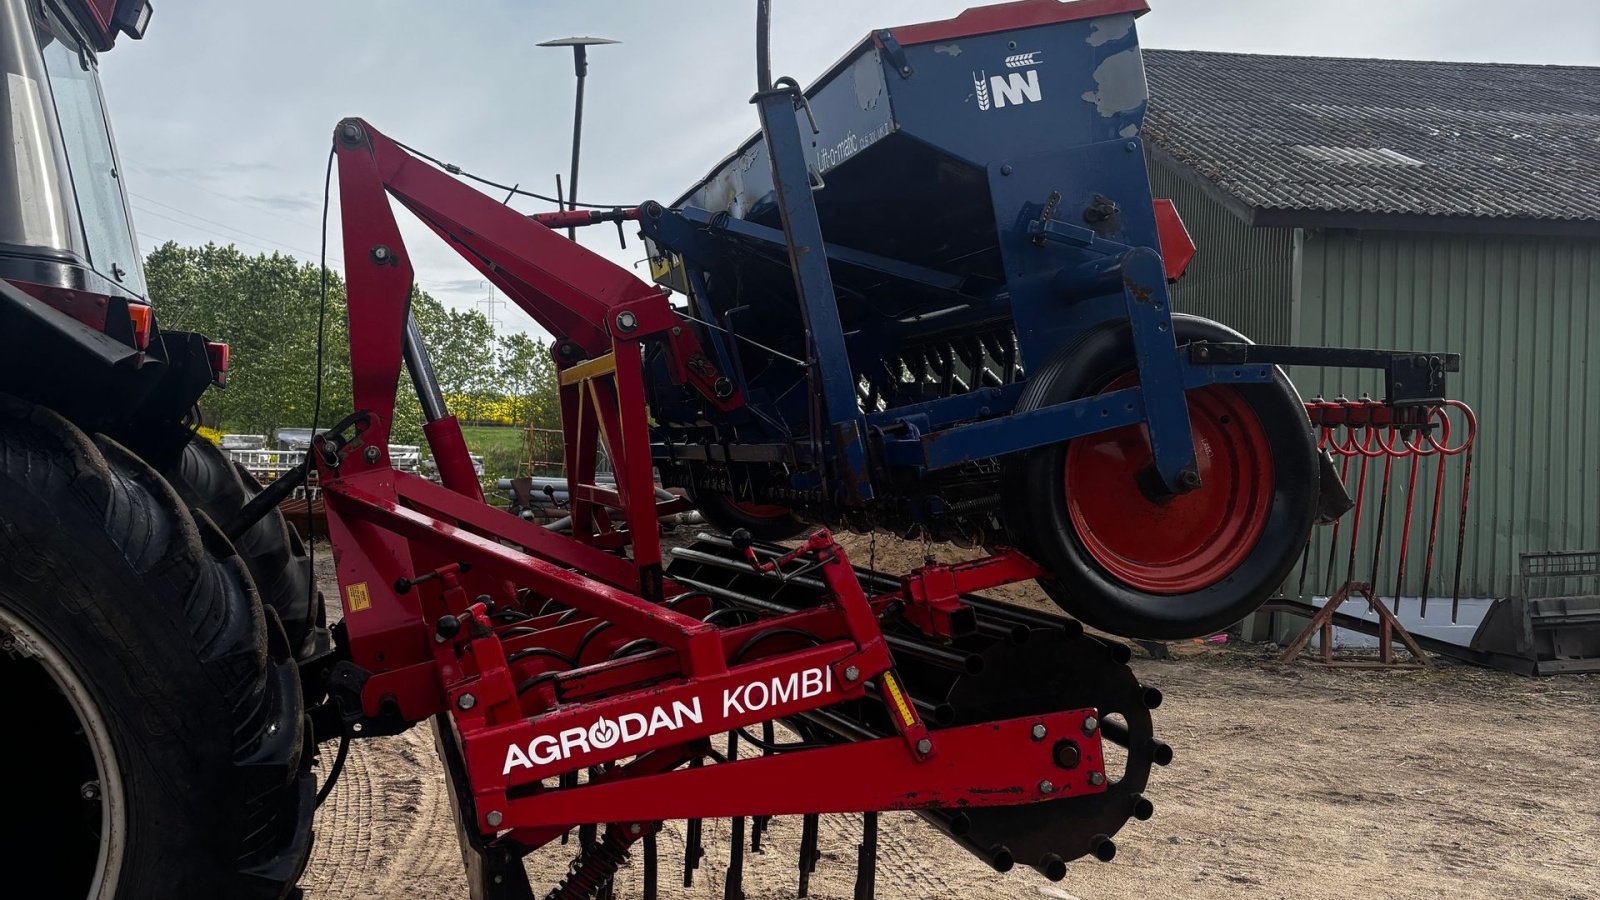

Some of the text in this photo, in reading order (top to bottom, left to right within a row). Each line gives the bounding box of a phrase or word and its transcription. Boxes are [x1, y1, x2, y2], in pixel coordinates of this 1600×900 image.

[817, 129, 858, 173] Lift-o-matic
[502, 696, 703, 775] AGRODAN
[723, 665, 832, 718] KOMBI
